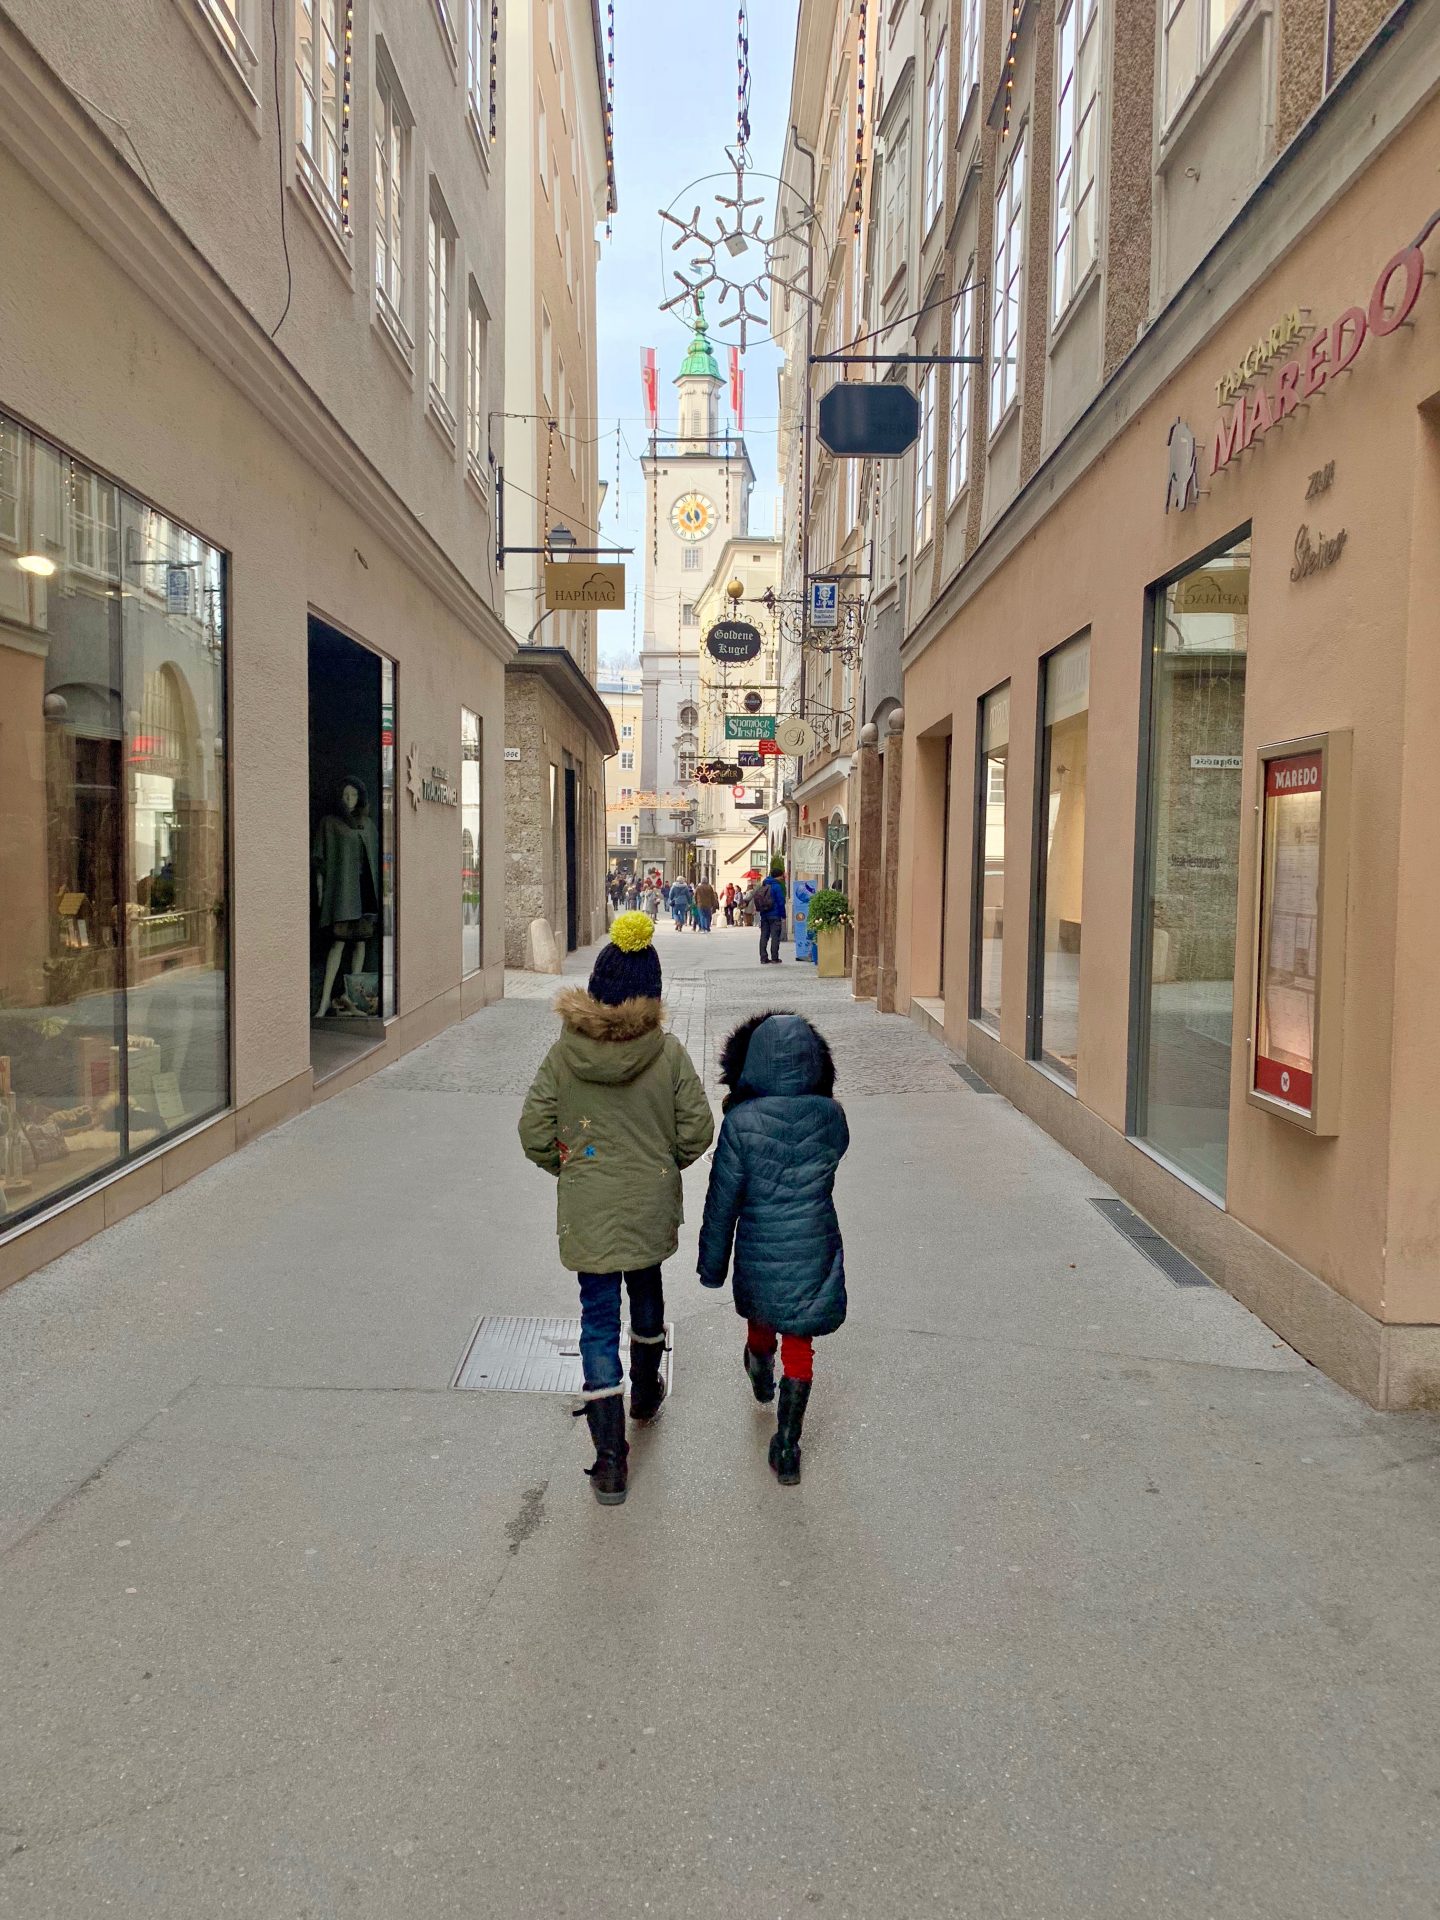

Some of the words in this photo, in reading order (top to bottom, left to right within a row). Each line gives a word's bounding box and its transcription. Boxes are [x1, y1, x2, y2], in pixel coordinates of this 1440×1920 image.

[1210, 246, 1425, 476] MAREDO
[555, 590, 616, 602] HAPIMAG
[714, 629, 754, 641] Goldene
[718, 643, 749, 656] Kugel
[737, 727, 756, 737] Irish
[756, 728, 770, 738] Pub
[1275, 766, 1318, 789] MAREDO
